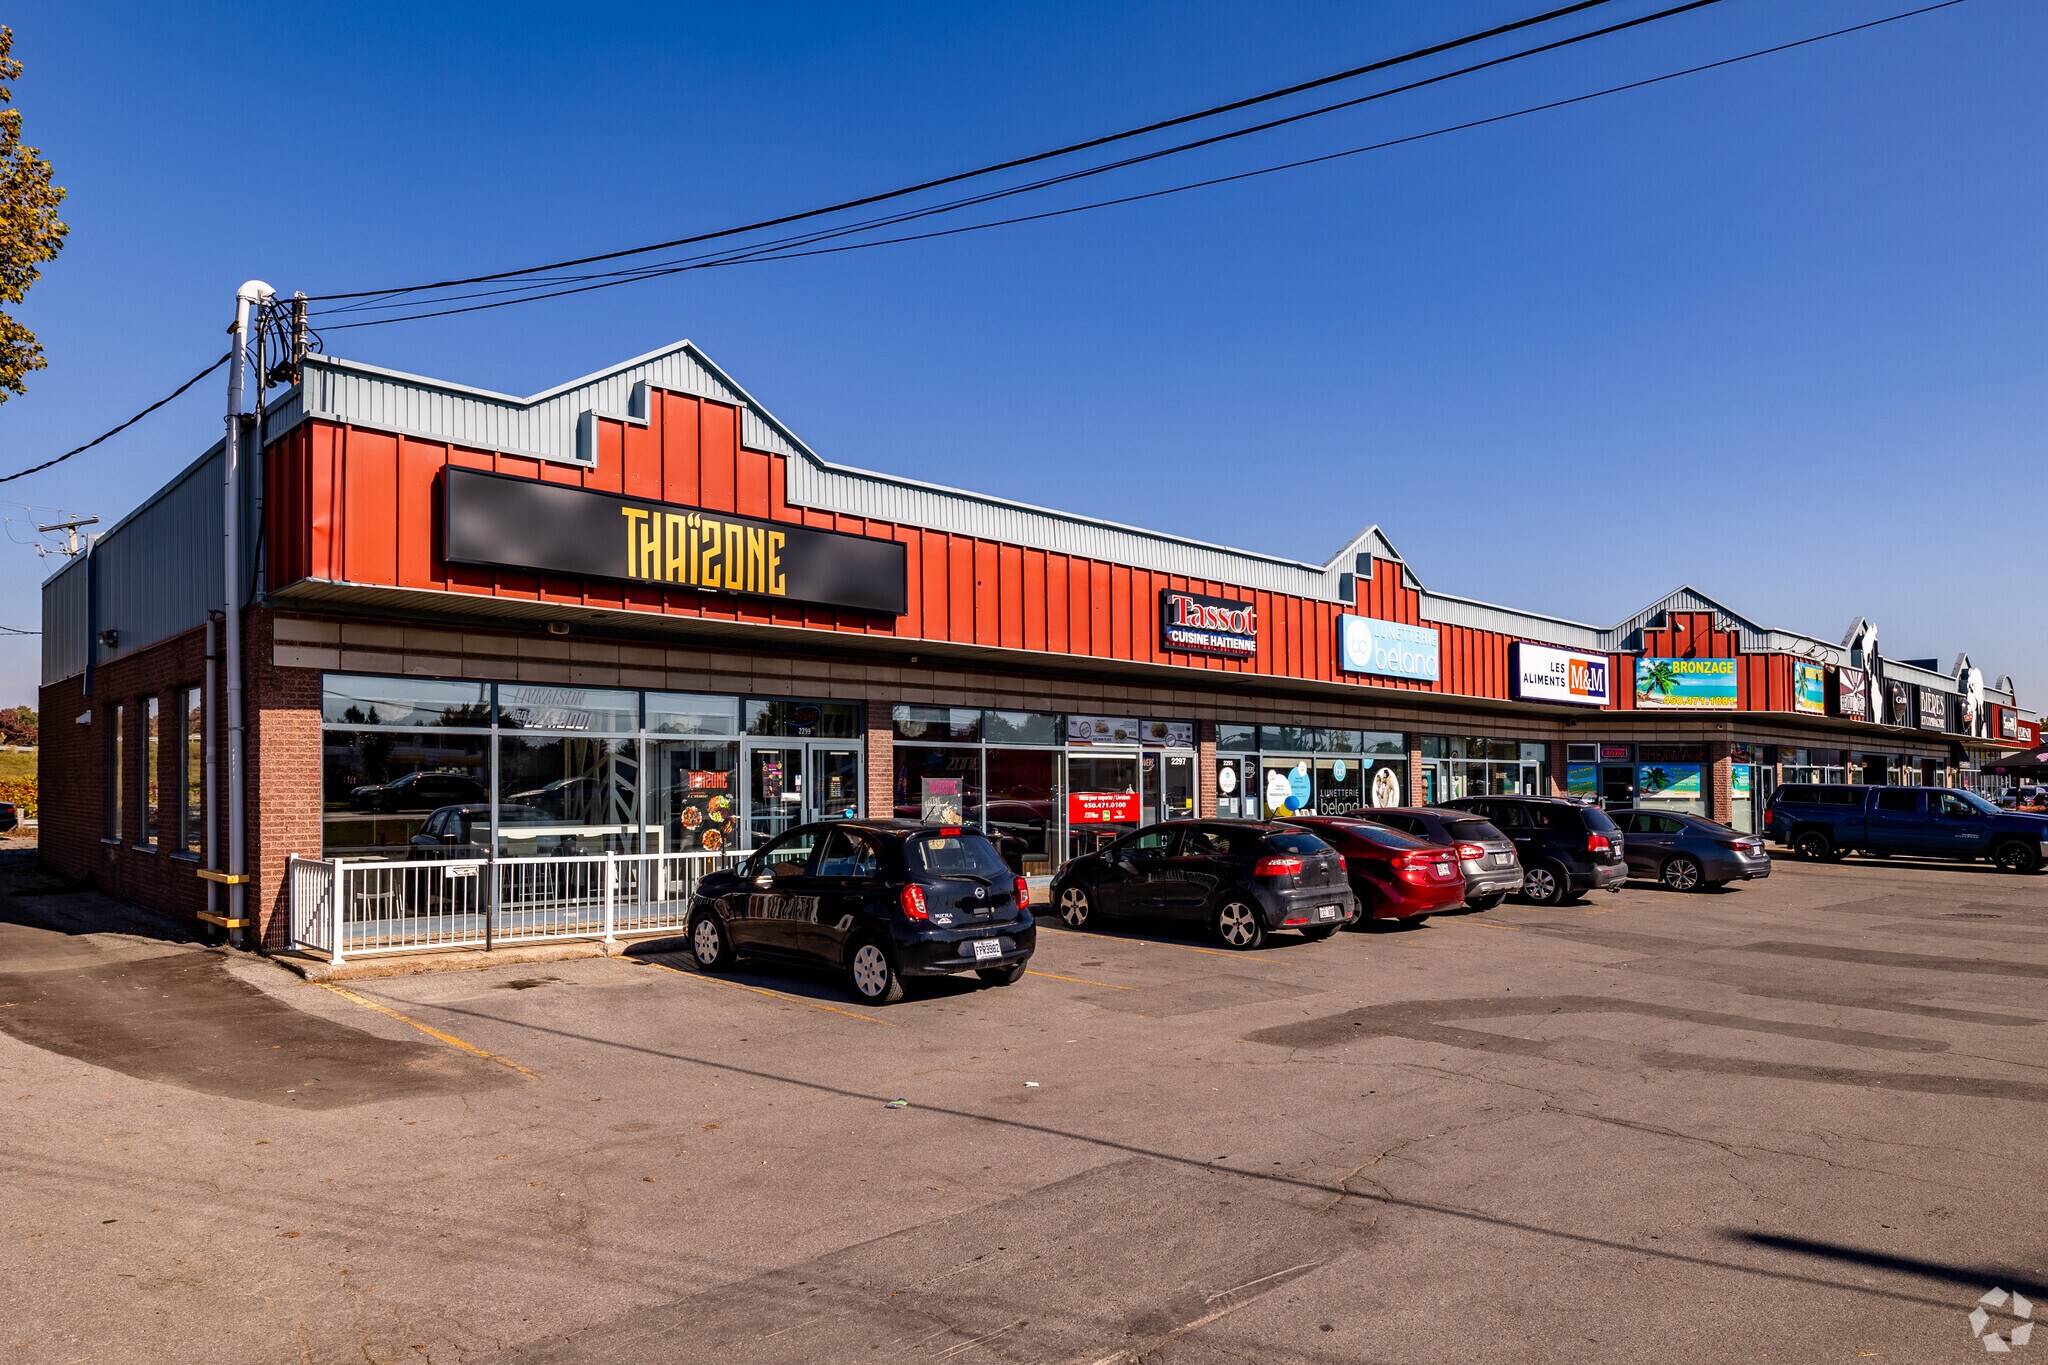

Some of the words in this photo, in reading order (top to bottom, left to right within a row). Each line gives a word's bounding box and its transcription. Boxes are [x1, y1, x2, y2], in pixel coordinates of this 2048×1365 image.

[1171, 595, 1257, 635] Tassot
[1171, 630, 1209, 645] CUISINE
[1374, 623, 1437, 647] LUNETTERIE
[1375, 639, 1437, 676] beland
[1551, 662, 1565, 673] LES
[1672, 661, 1734, 674] BRONZAGE
[1523, 673, 1565, 687] ALIMENTS
[1571, 664, 1603, 692] M&M
[514, 687, 586, 705] LIVRAISON
[1663, 696, 1735, 706] 450.471.1881
[1171, 757, 1187, 766] 2297
[1320, 788, 1359, 798] LUNETTERIE
[1321, 797, 1360, 815] beland
